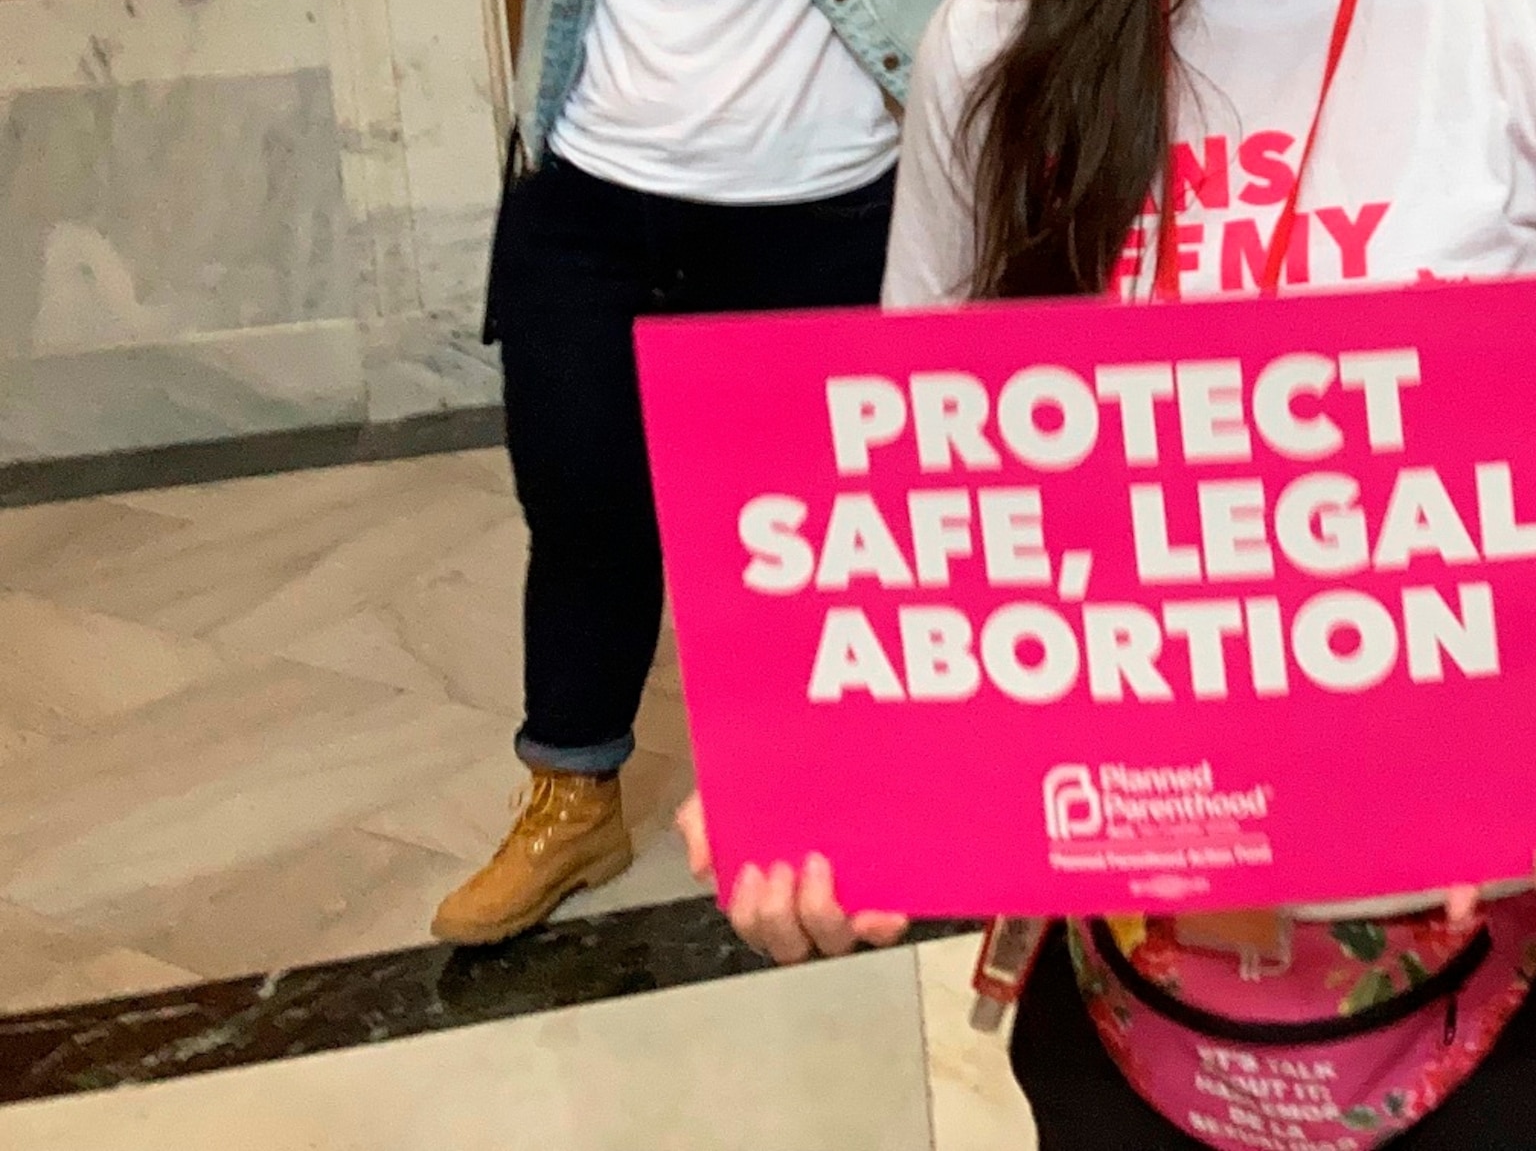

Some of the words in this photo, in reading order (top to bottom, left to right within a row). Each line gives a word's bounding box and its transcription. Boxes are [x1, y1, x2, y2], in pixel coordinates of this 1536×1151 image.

[826, 348, 1421, 475] PROTECT
[738, 485, 1093, 601] SAFE,
[807, 582, 1500, 704] ABORTION
